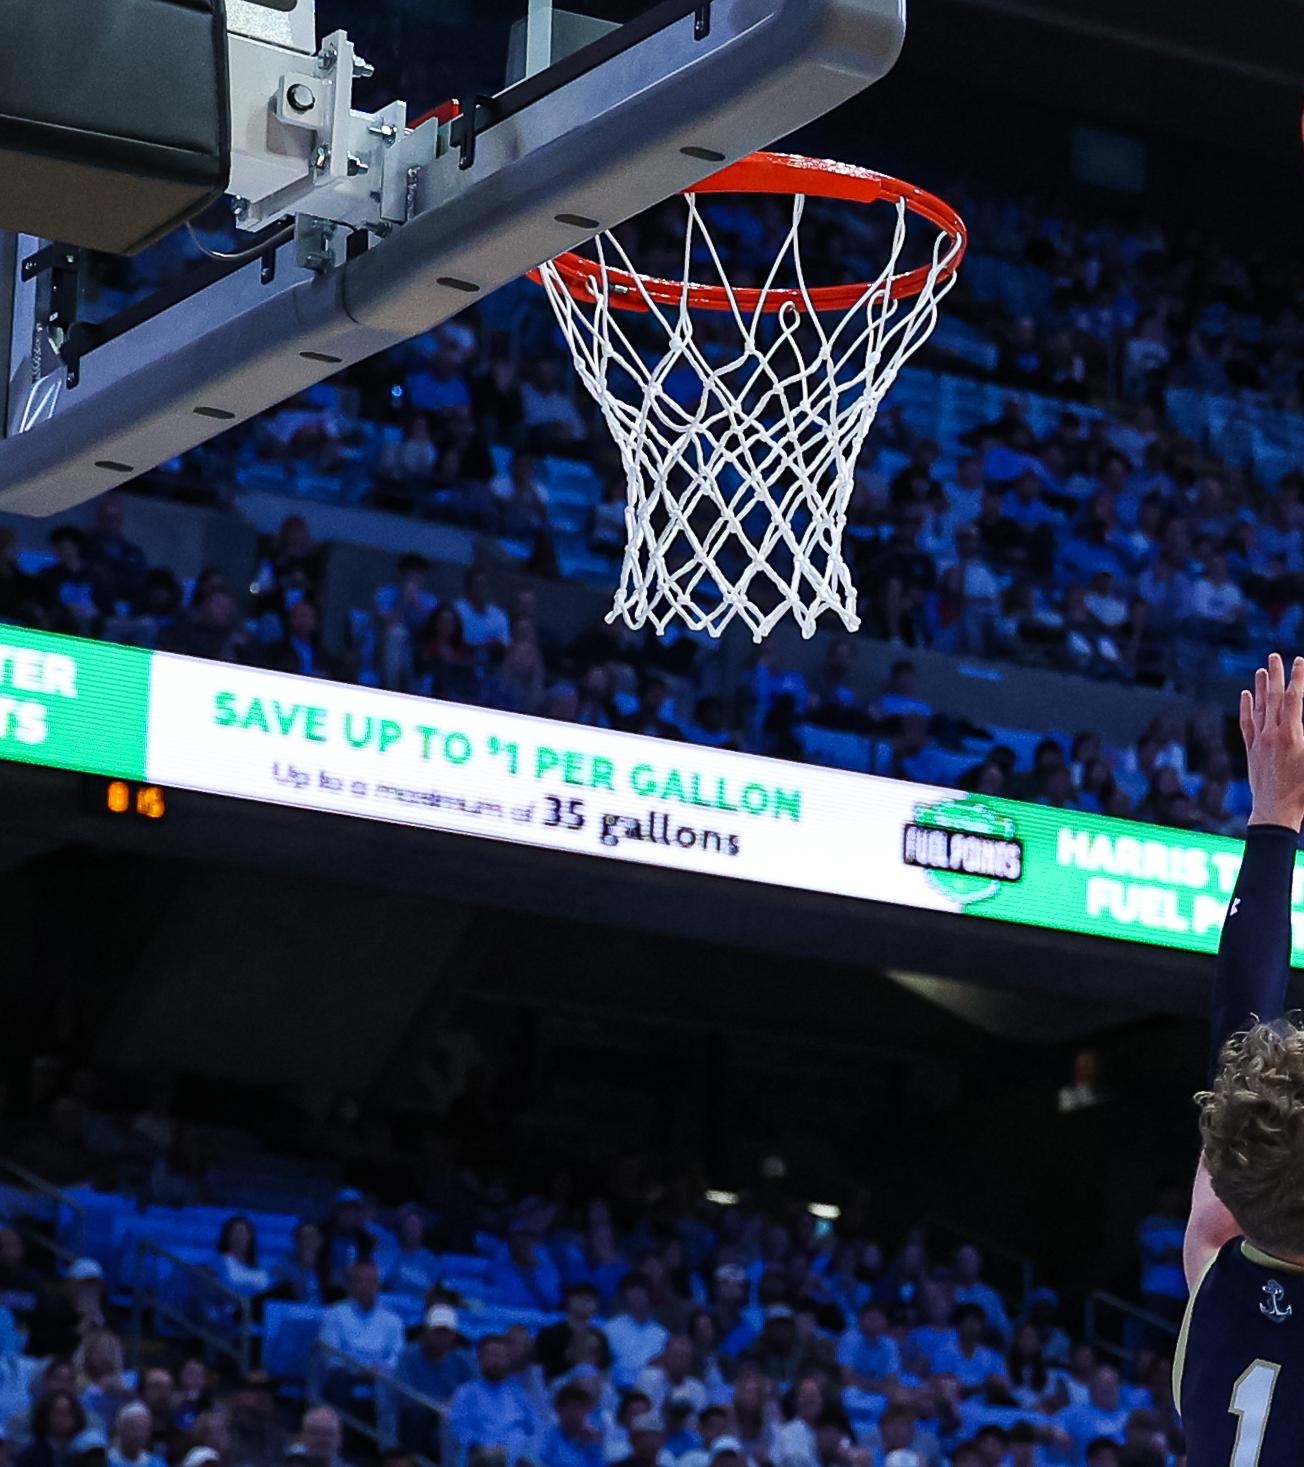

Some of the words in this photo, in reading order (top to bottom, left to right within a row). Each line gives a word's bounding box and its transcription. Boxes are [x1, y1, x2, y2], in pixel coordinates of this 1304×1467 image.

[213, 691, 328, 743] SAVE
[344, 712, 403, 753] UP
[416, 724, 472, 765] TO
[536, 746, 616, 791] PER
[630, 762, 802, 822] GALLON
[544, 794, 585, 829] 35
[600, 810, 741, 855] gallons
[1056, 828, 1211, 888] HARRIS
[1087, 876, 1188, 932] FUEL
[1228, 1359, 1282, 1467] 1
